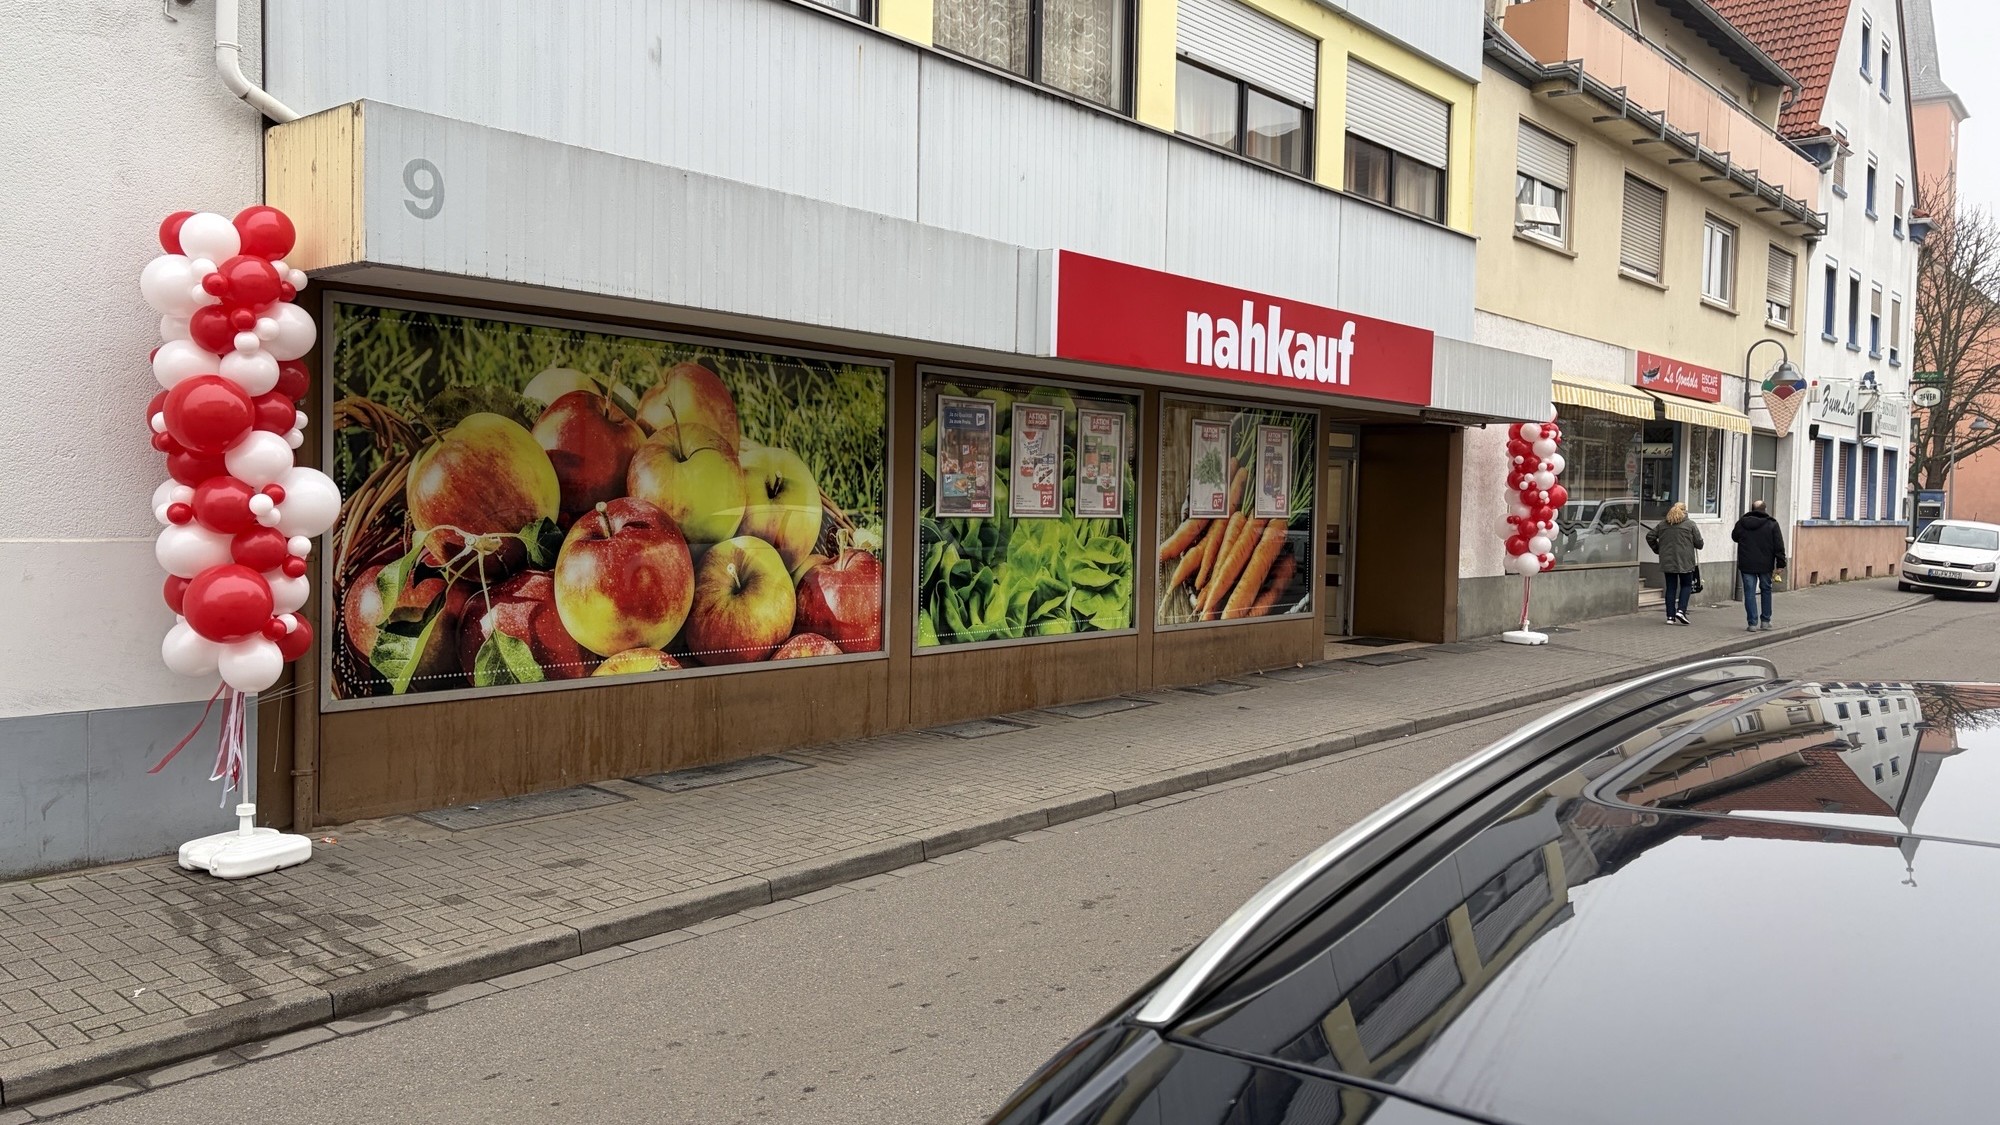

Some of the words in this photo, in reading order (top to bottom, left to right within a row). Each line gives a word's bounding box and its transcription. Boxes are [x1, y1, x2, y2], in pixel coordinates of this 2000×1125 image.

[402, 158, 444, 220] 9
[1185, 299, 1356, 386] nahkauf
[1664, 364, 1674, 384] La
[1676, 366, 1698, 392] Gondola
[1821, 384, 1840, 418] Zum
[1840, 390, 1856, 416] Leo
